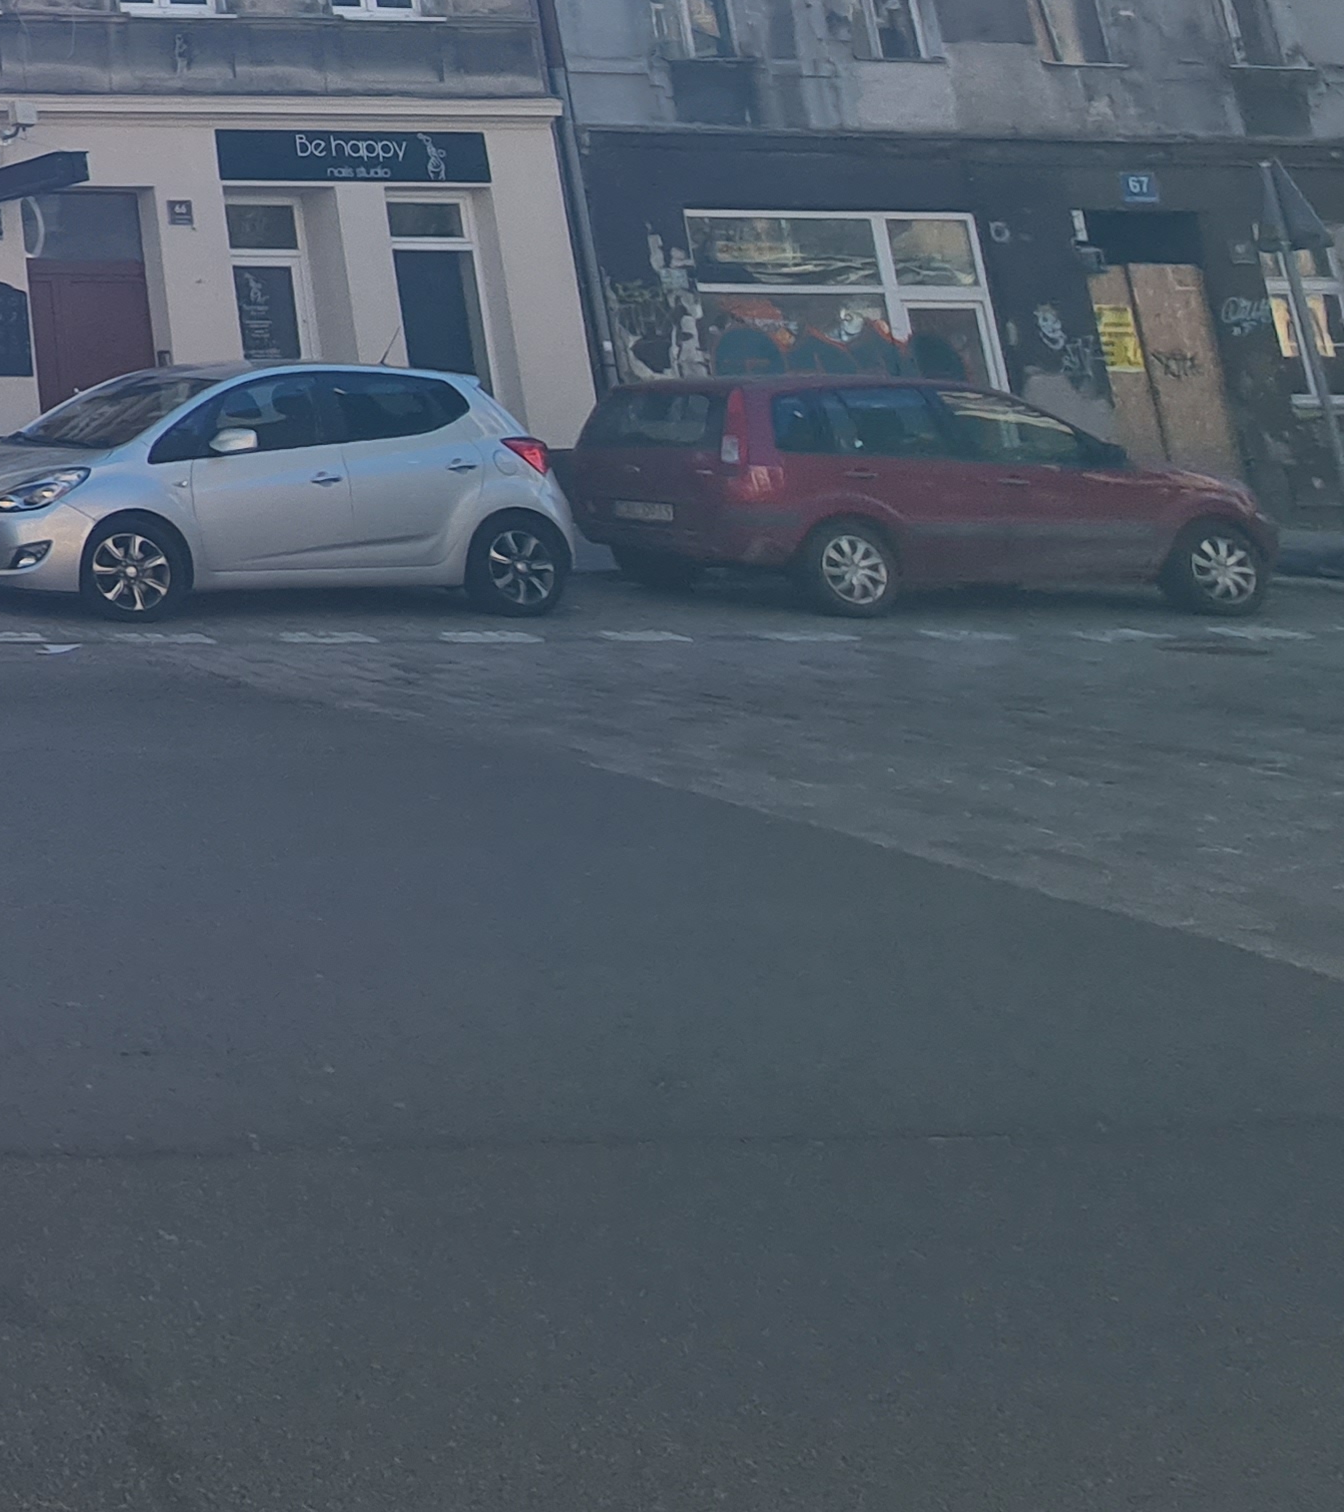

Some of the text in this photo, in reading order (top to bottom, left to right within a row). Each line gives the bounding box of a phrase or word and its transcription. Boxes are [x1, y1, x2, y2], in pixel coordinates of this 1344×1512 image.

[295, 134, 407, 162] Be happy
[327, 165, 391, 178] nails studio
[1128, 176, 1149, 194] 67
[174, 203, 188, 214] 66
